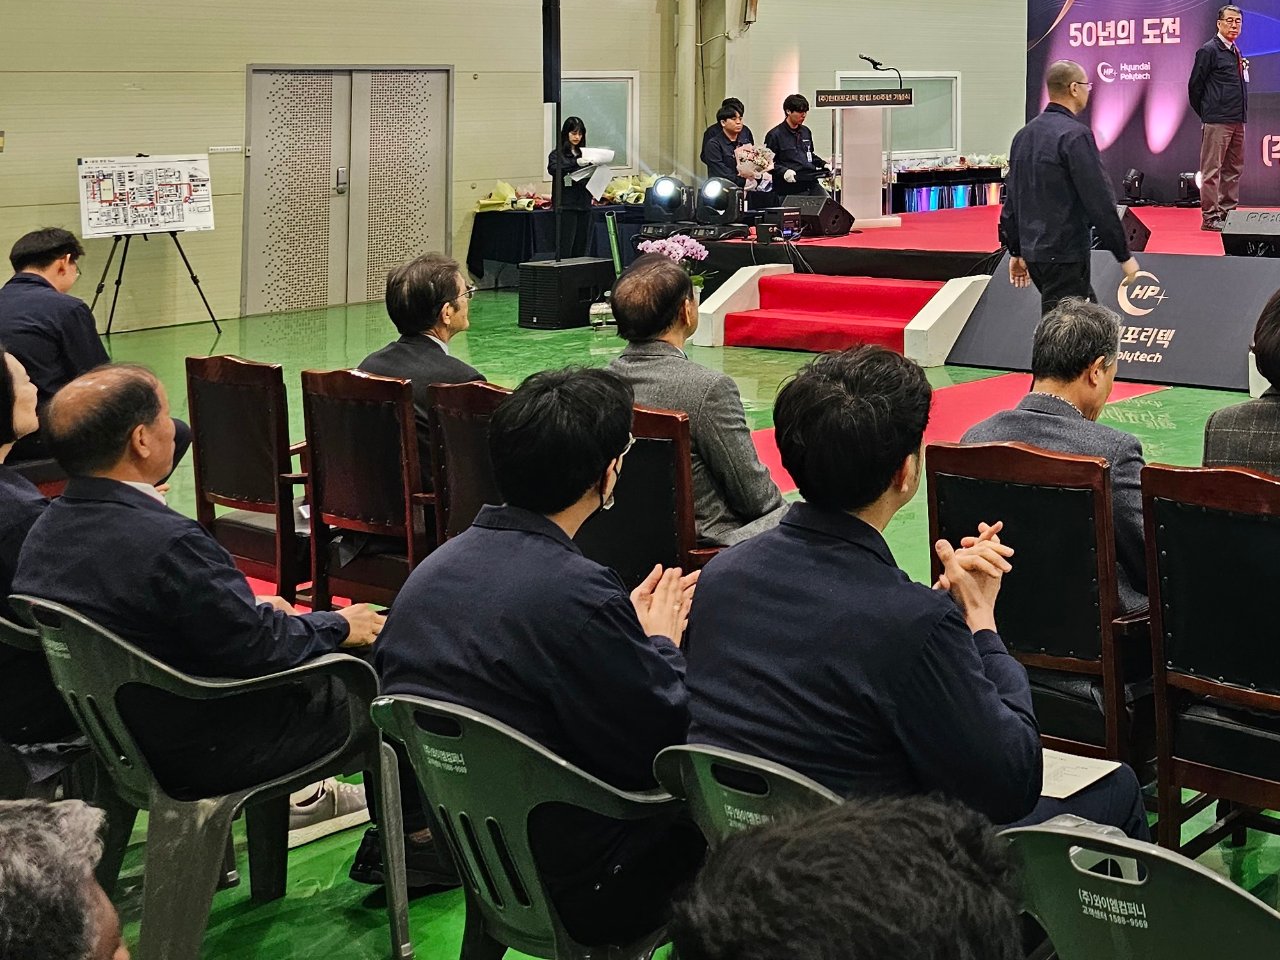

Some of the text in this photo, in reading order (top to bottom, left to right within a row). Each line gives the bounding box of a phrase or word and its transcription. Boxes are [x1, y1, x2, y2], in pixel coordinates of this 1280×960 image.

[1069, 17, 1180, 47] 50년의 도전
[1120, 62, 1151, 72] Hyundai
[1120, 72, 1151, 81] Polytech
[1119, 326, 1176, 348] 포리텍
[1117, 350, 1163, 363] olytech
